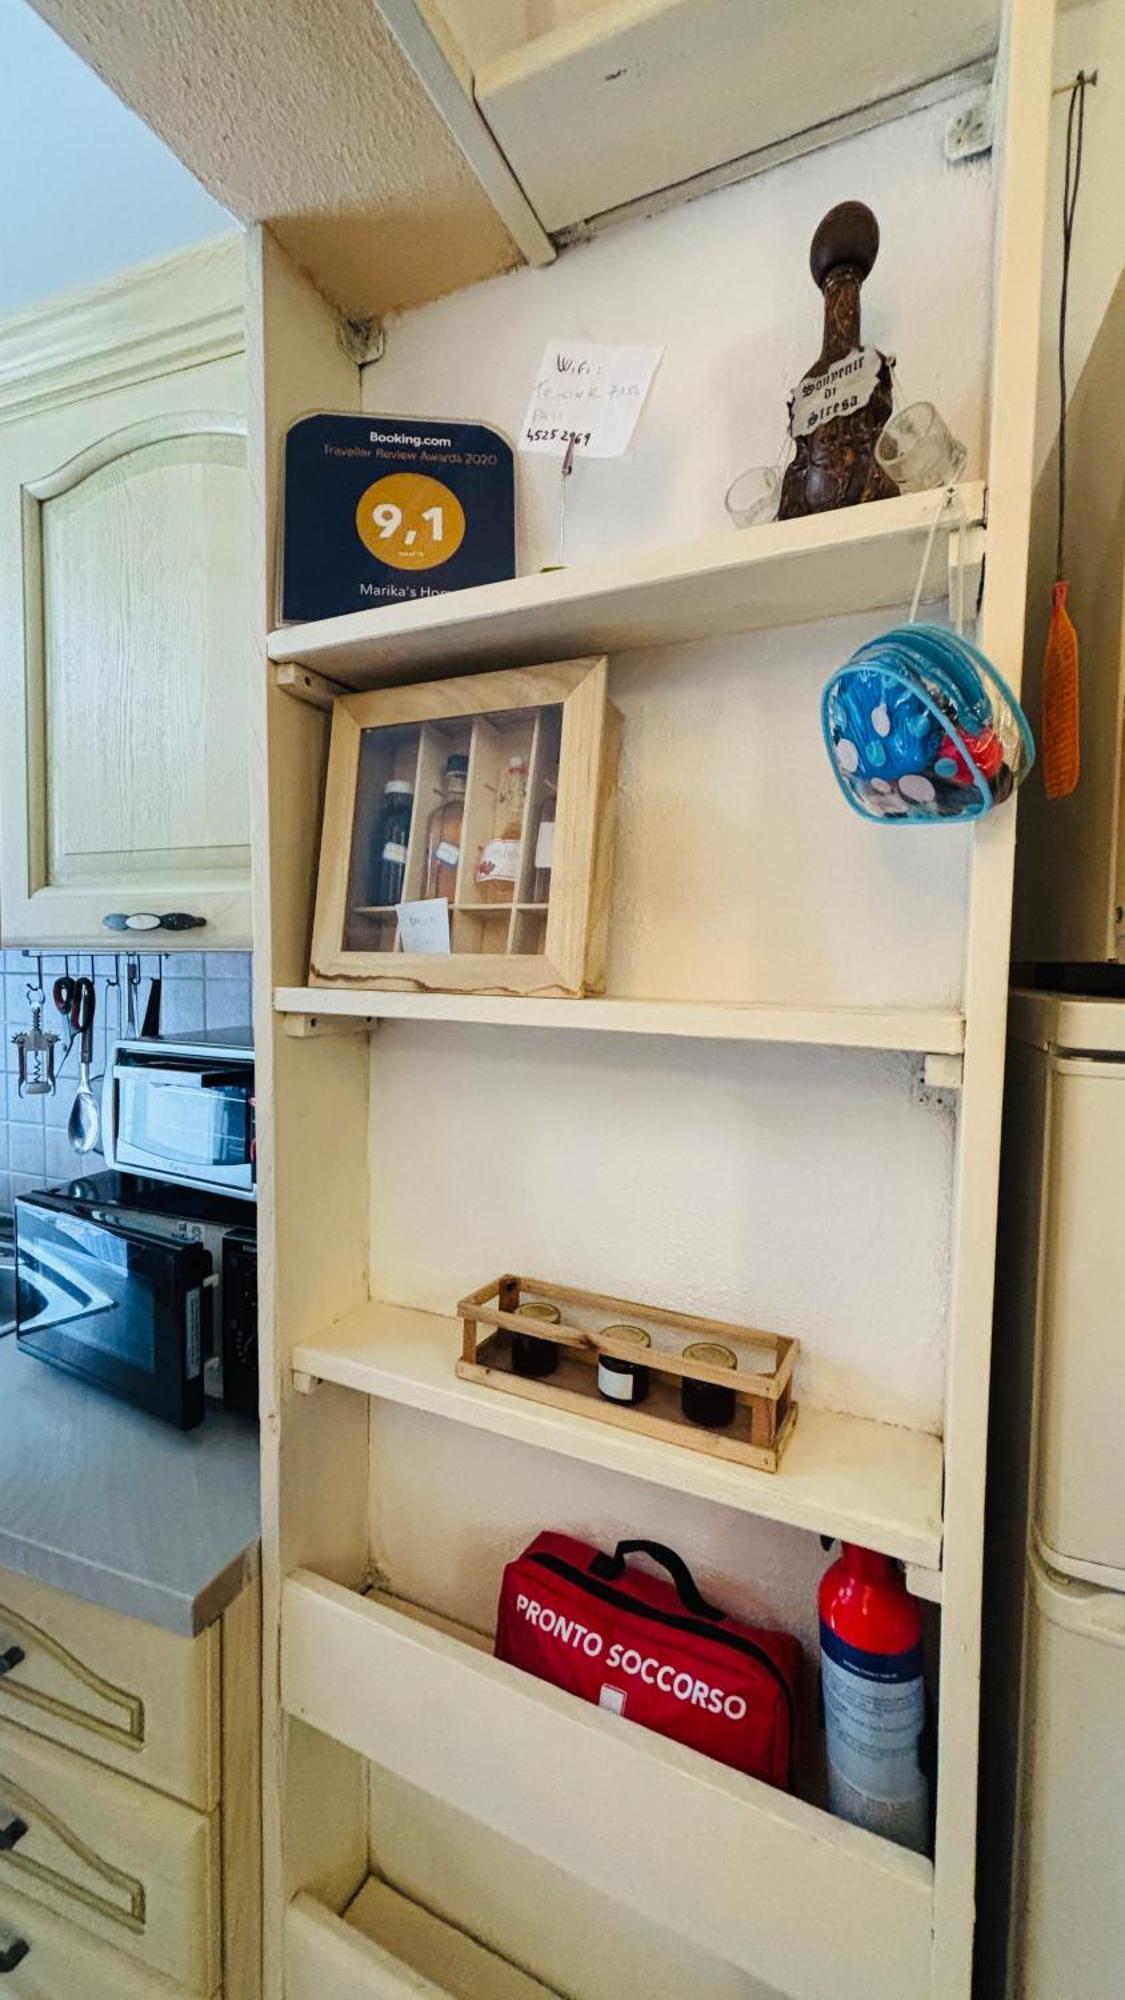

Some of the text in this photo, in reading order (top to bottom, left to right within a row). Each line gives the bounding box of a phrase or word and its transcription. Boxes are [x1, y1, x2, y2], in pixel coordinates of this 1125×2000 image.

[802, 356, 865, 397] Souvenir
[824, 386, 837, 399] di
[369, 431, 452, 448] Booking.com
[322, 443, 498, 466] Traveller Review Awards 2020
[372, 503, 444, 546] 9,1
[359, 583, 417, 598] Marika's
[516, 1594, 603, 1657] PRONTO
[606, 1644, 748, 1720] SOCCORSO
